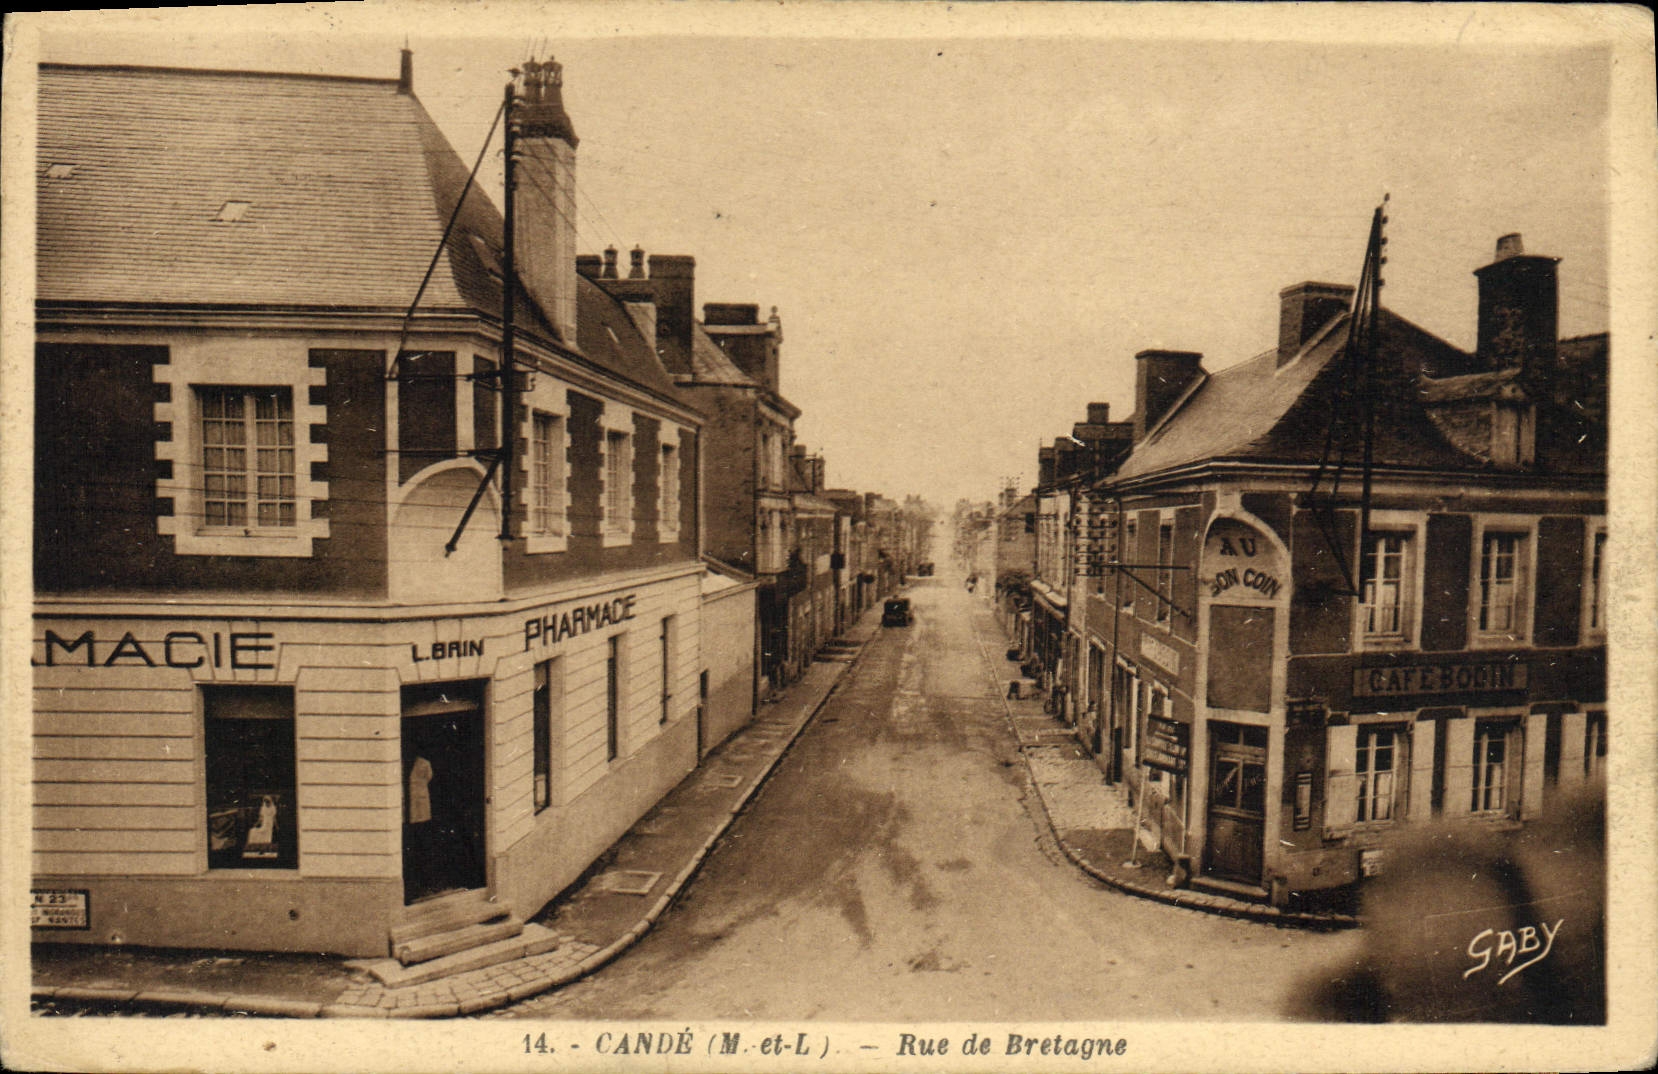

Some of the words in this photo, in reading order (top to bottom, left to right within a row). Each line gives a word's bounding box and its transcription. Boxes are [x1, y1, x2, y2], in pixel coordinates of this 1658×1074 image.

[1220, 537, 1256, 557] AU
[1243, 567, 1283, 599] COIN
[31, 630, 275, 669] MACIE
